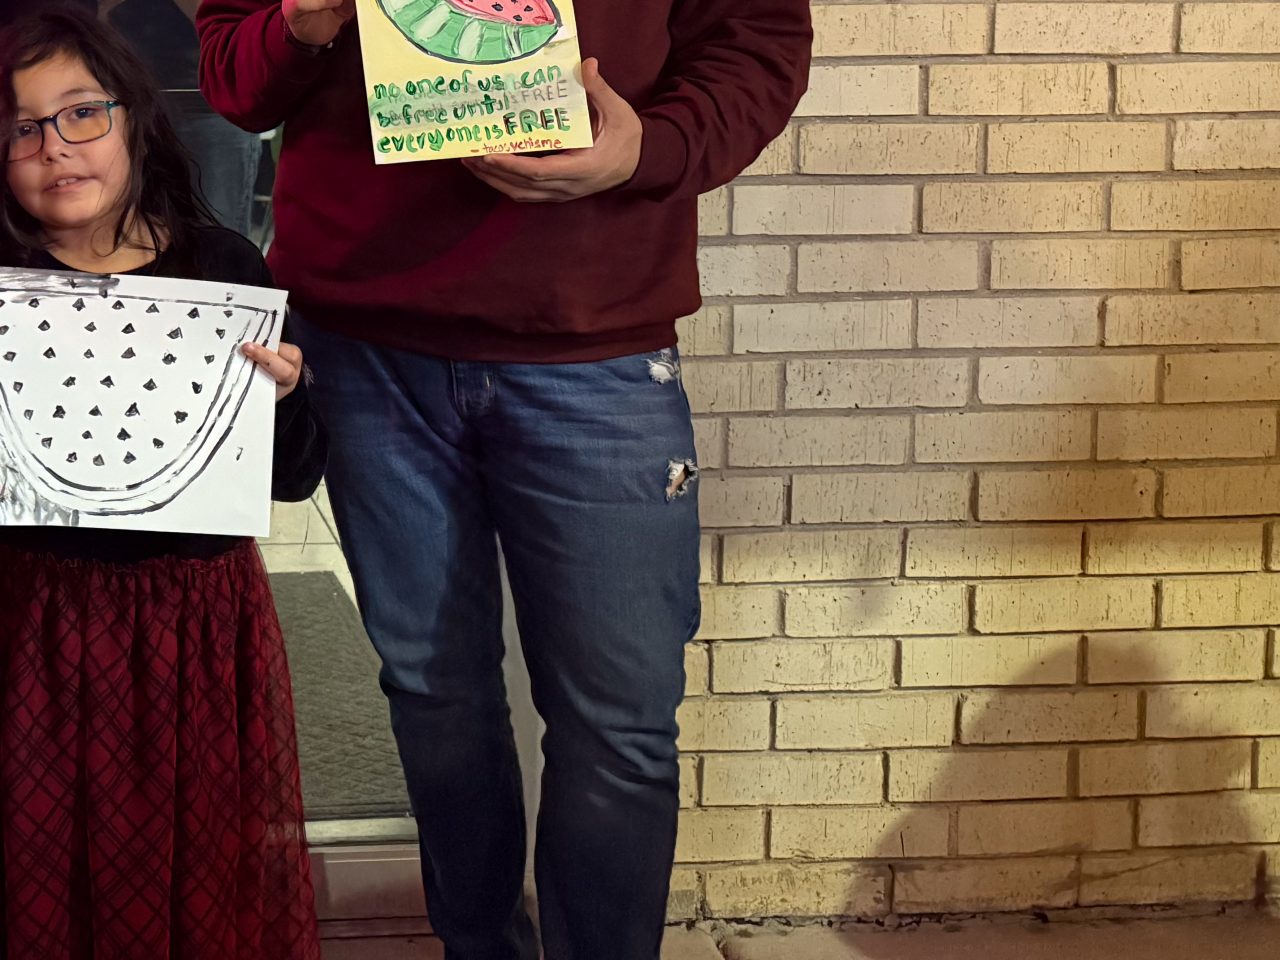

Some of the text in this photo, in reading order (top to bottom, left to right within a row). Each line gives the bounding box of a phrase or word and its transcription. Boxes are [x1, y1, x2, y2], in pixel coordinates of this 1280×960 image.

[478, 75, 505, 91] us
[521, 65, 561, 89] can
[502, 107, 571, 136] FREE
